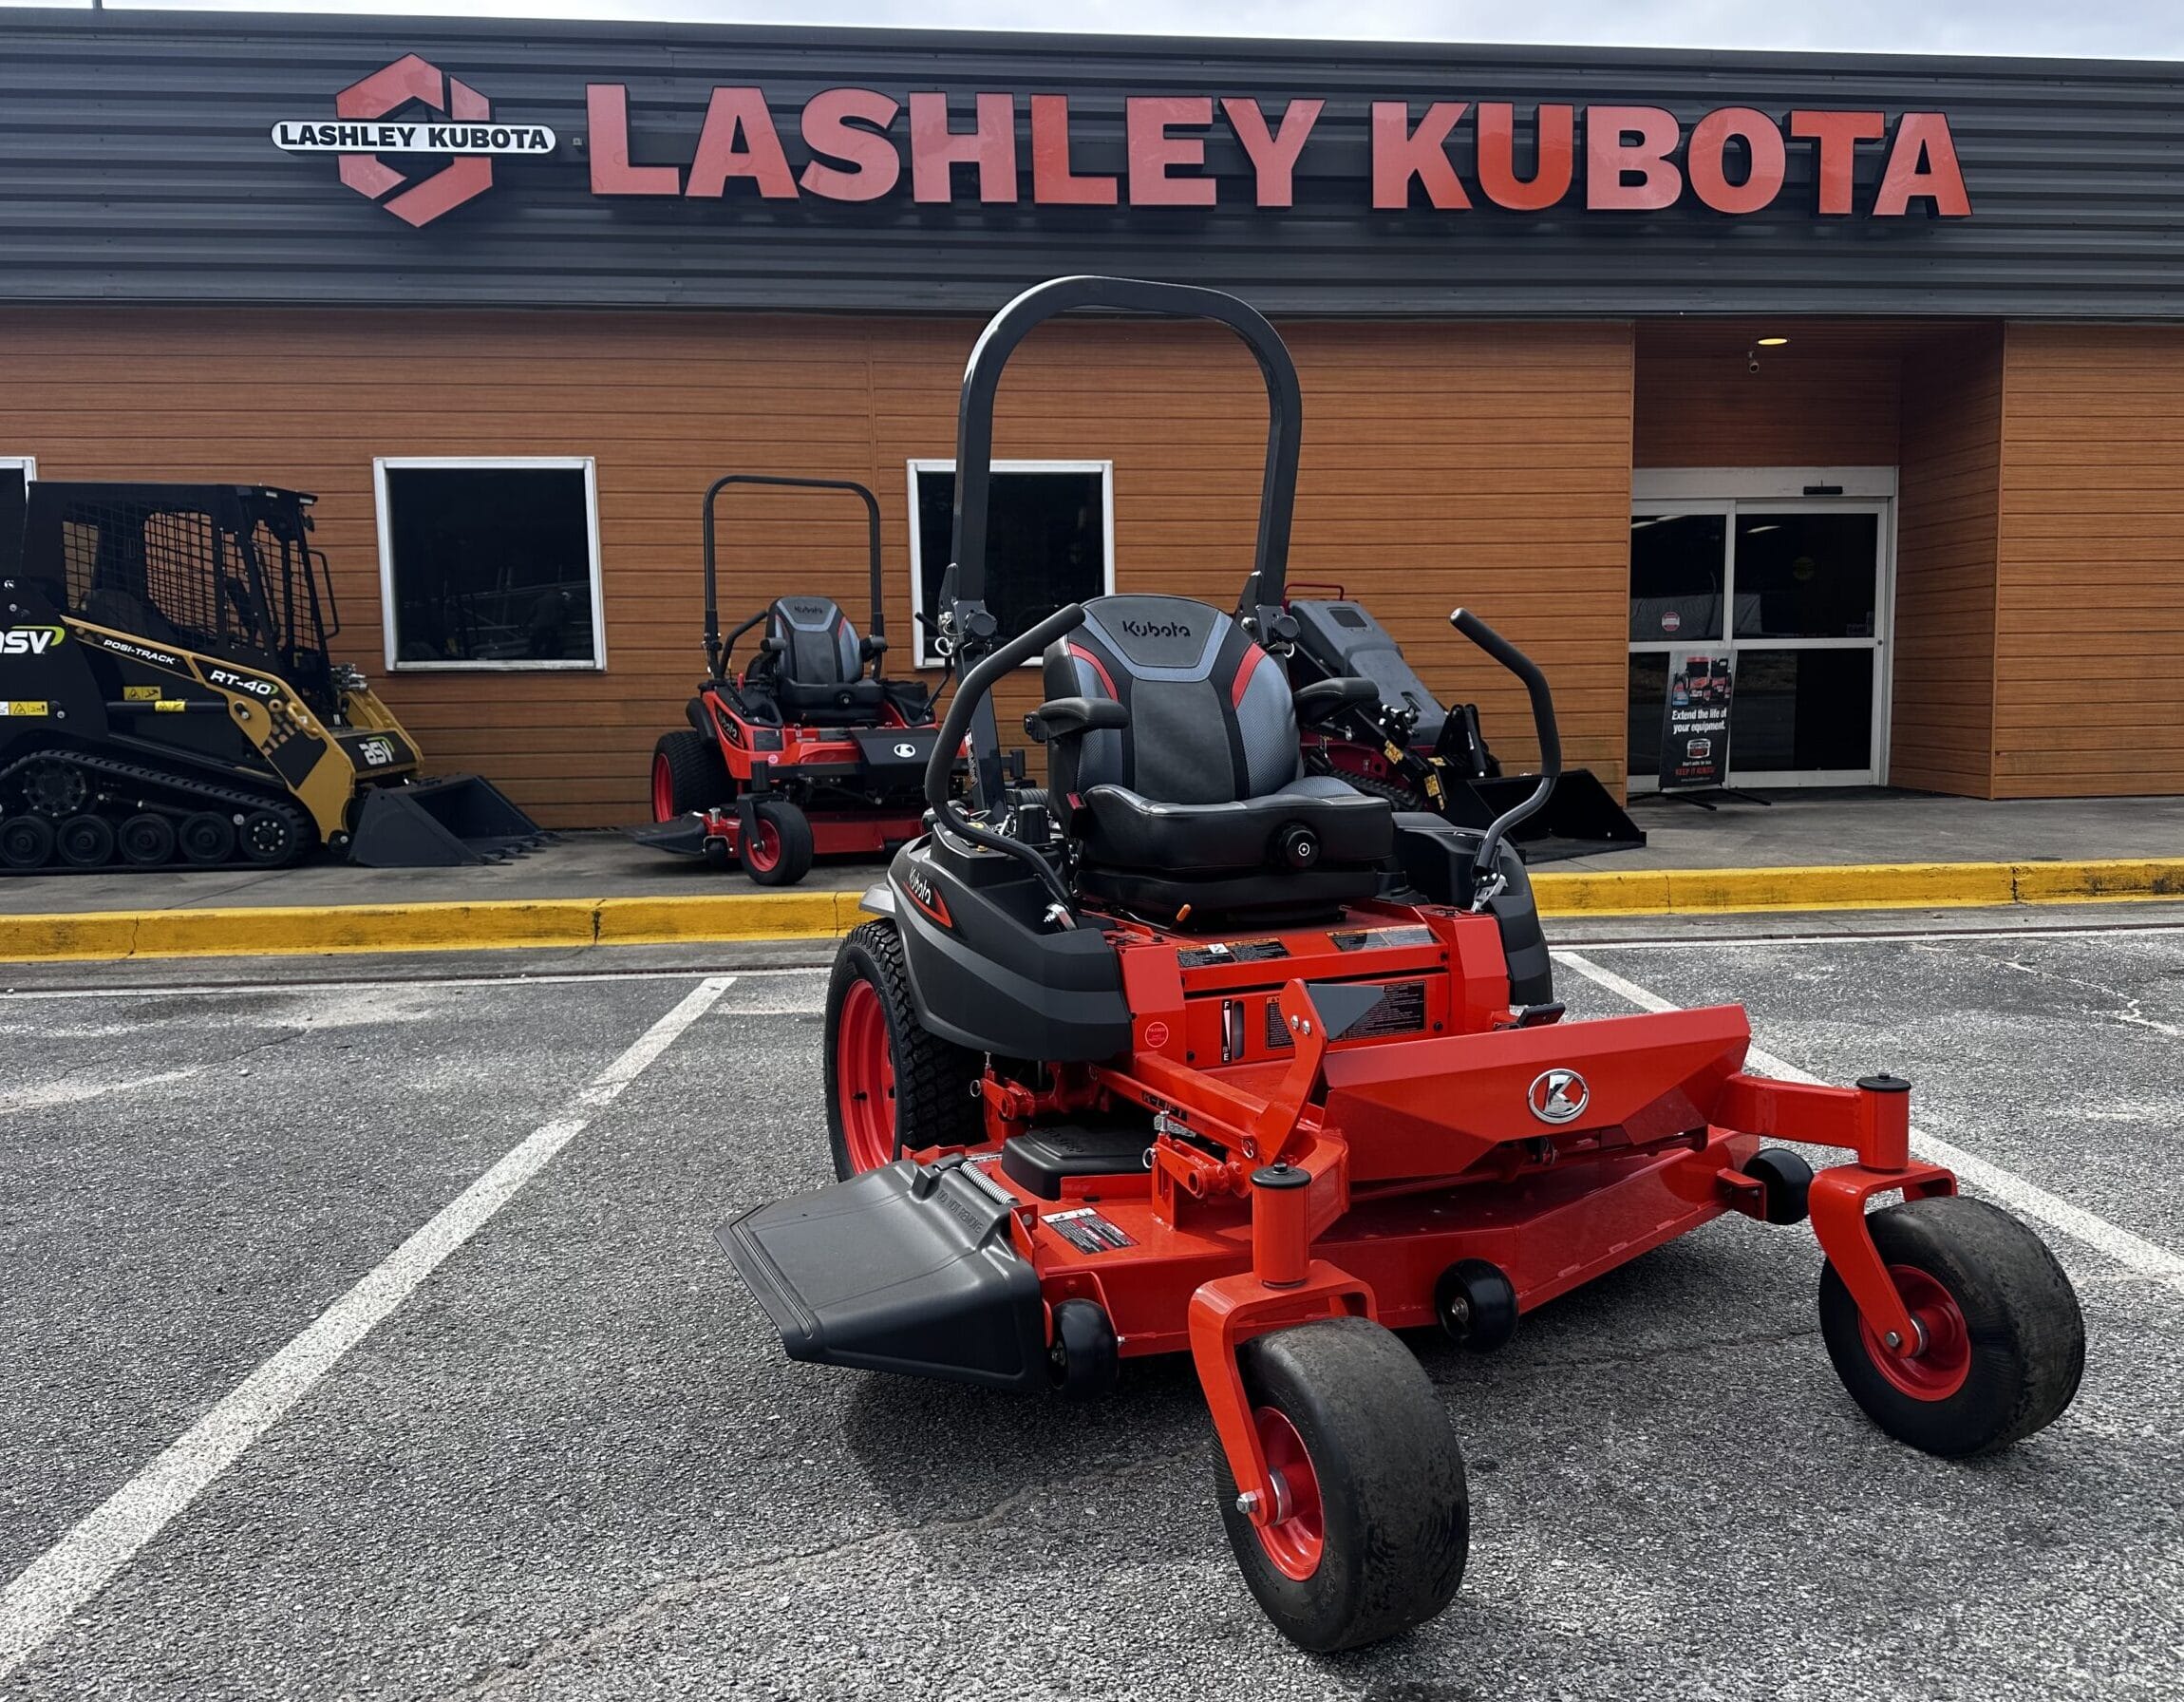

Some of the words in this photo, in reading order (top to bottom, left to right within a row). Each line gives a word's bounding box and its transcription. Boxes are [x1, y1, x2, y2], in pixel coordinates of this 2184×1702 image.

[280, 124, 416, 147] LASHLEY
[428, 127, 549, 149] KUBOTA
[586, 84, 1326, 207] LASHLEY
[1371, 101, 1973, 216] KUBOTA
[1122, 620, 1192, 637] Kubota
[104, 639, 176, 664] POSI-TRACK
[210, 670, 272, 694] RT-40
[1672, 709, 1697, 720] Extend
[1698, 709, 1708, 719] the
[1709, 708, 1720, 718] life
[1721, 707, 1727, 717] of
[1673, 724, 1690, 735] your
[1691, 720, 1725, 733] equipment.
[910, 865, 932, 905] Kubota
[1223, 1052, 1230, 1061] E
[937, 1189, 950, 1203] DO
[949, 1200, 962, 1213] NOT
[958, 1207, 985, 1233] REMOVE
